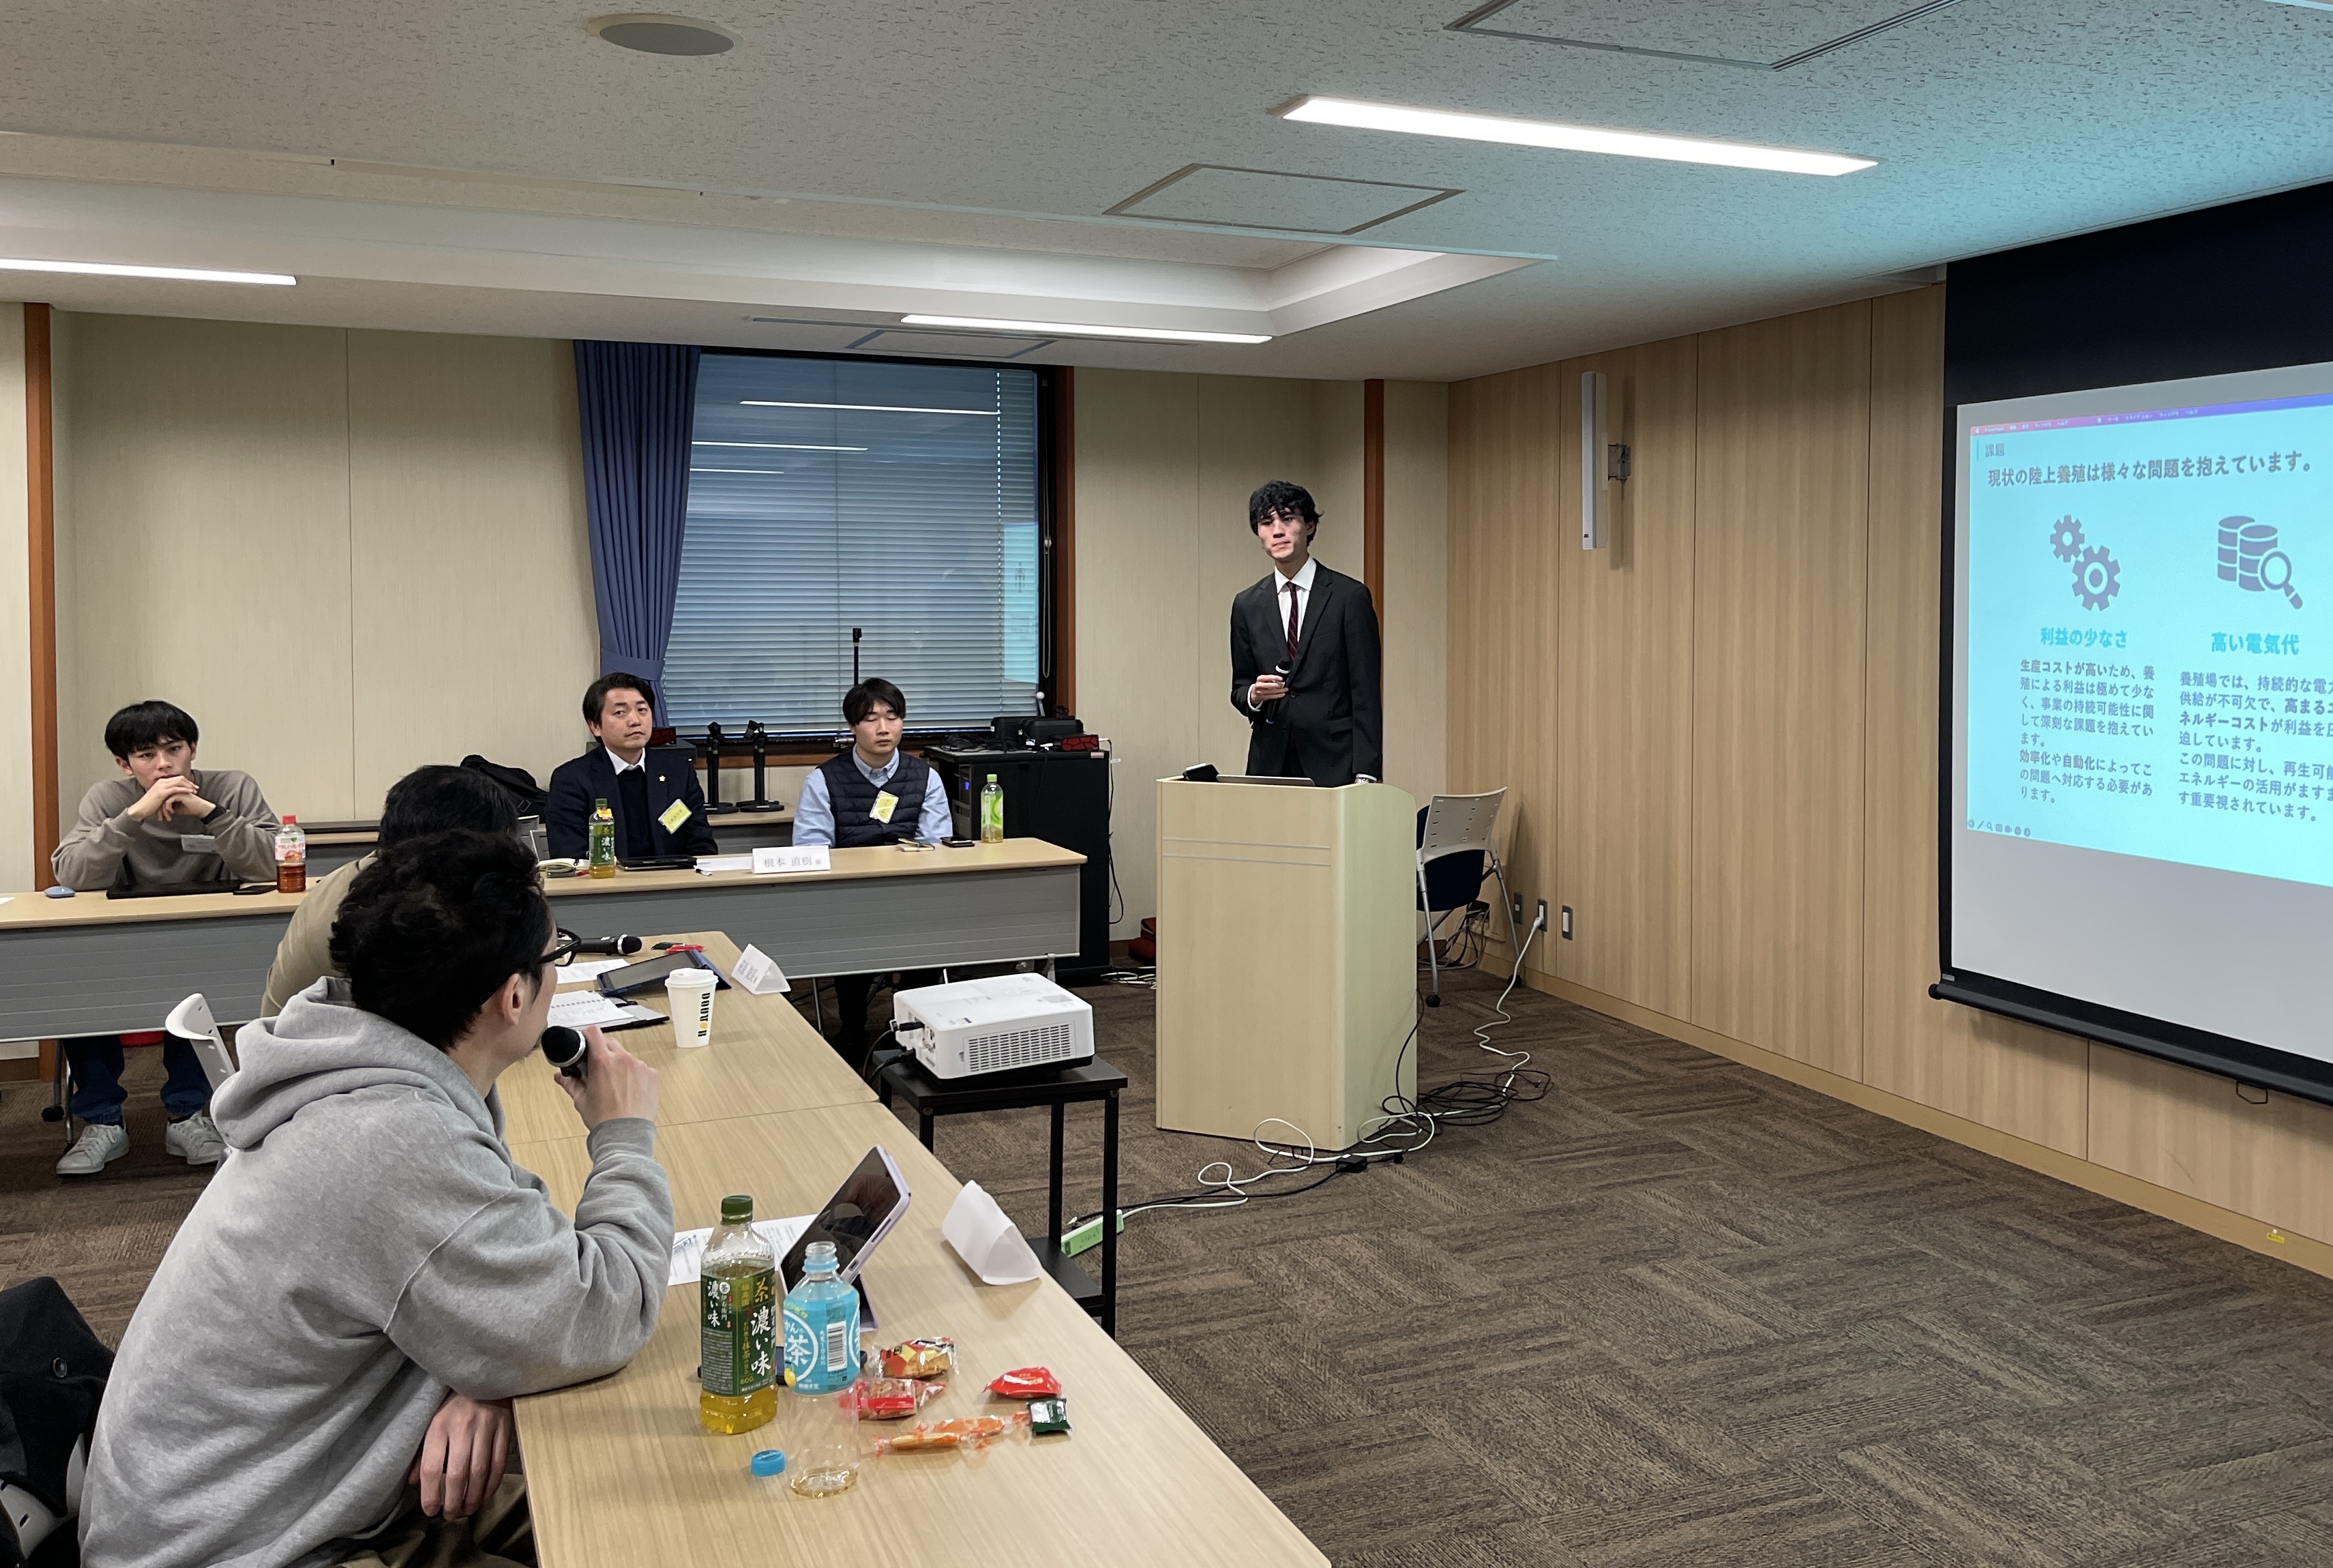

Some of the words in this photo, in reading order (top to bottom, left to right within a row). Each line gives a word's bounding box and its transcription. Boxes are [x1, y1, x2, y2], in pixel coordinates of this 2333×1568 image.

[1985, 443, 2005, 458] 課題
[1988, 450, 2310, 487] 現状の陸上養殖は様々な問題を抱えています。
[2040, 626, 2128, 648] 利益の少なさ
[2211, 632, 2300, 655] 高い電気代
[2020, 658, 2155, 681] 生産コストが高いため、養
[2020, 677, 2154, 699] 殖による利益は極めて少な
[2021, 696, 2154, 720] く、事業の持続可能性に関
[2021, 713, 2154, 737] して深刻な課題を抱えてい
[2021, 732, 2045, 748] ます。
[2179, 730, 2261, 753] 迫しています。
[2019, 749, 2152, 777] 効率化や自動化によってこ
[2020, 769, 2153, 797] の問題へ対応する必要があ
[2021, 786, 2055, 803] ります。
[2178, 790, 2316, 822] す重要視されています。
[707, 1280, 720, 1328] 濃い味
[750, 1305, 771, 1377] 濃い味
